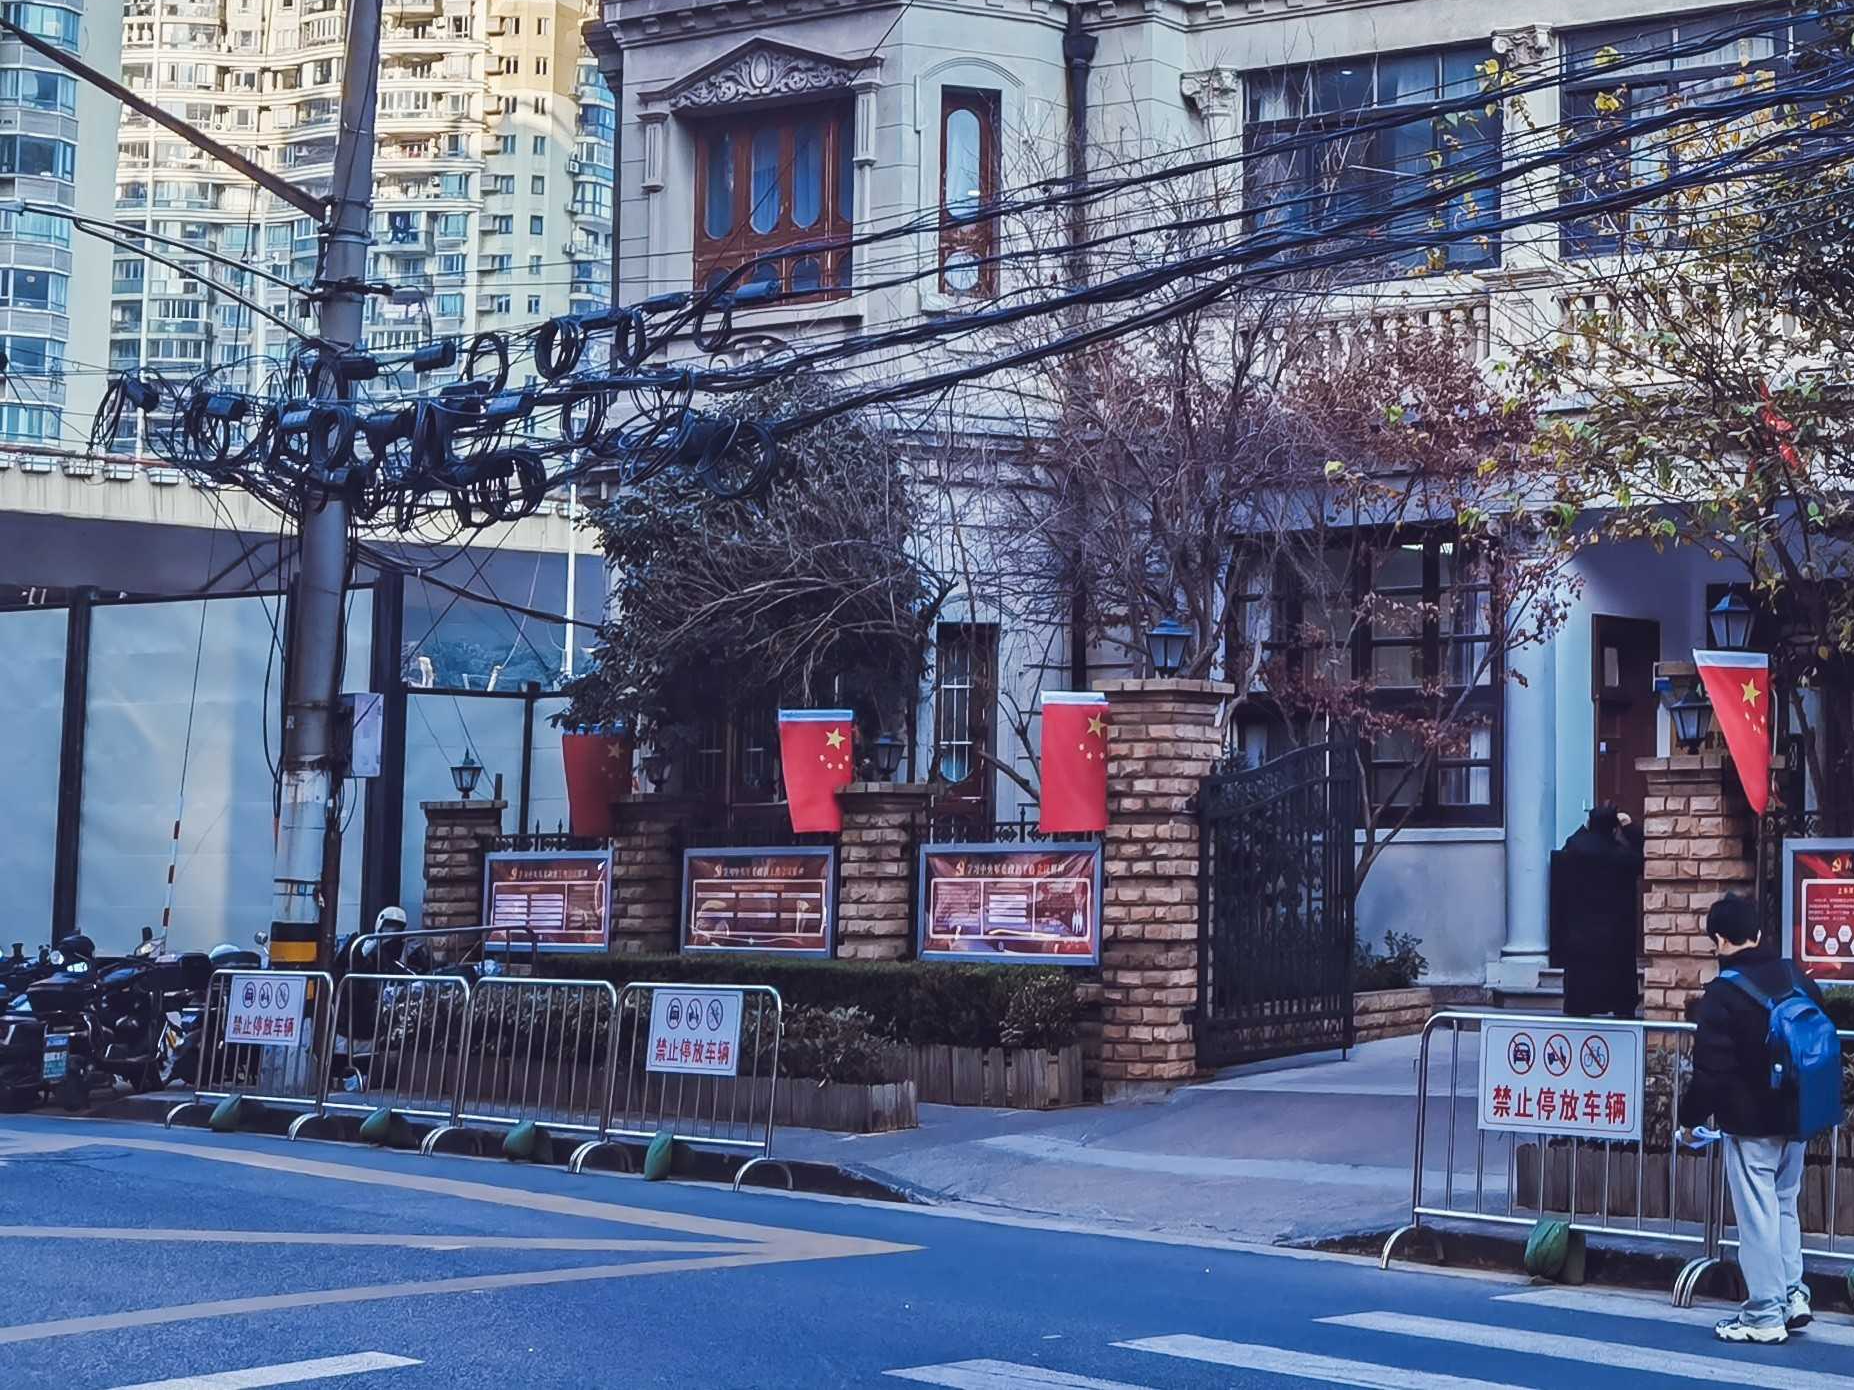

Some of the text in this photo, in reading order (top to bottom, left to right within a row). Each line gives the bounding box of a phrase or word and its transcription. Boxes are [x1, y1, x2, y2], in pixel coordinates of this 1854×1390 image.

[656, 1037, 730, 1065] 禁止停放车辆
[1492, 1084, 1626, 1125] 禁止停放车辆
